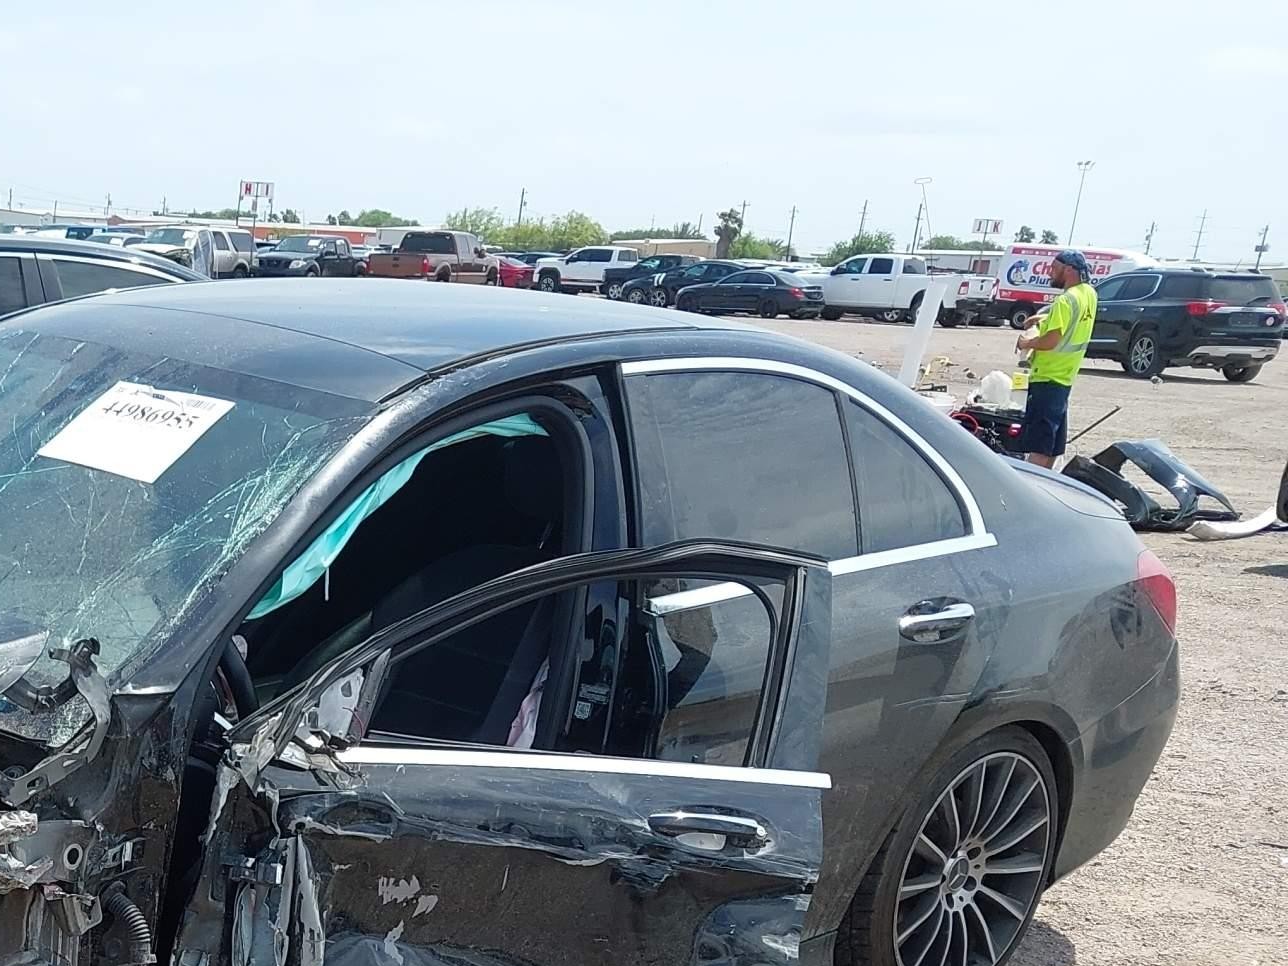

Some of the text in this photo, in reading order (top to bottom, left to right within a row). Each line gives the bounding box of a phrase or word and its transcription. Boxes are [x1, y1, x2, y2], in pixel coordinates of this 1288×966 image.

[244, 183, 252, 195] H
[976, 220, 1001, 233] J K
[102, 401, 200, 430] 44986955
